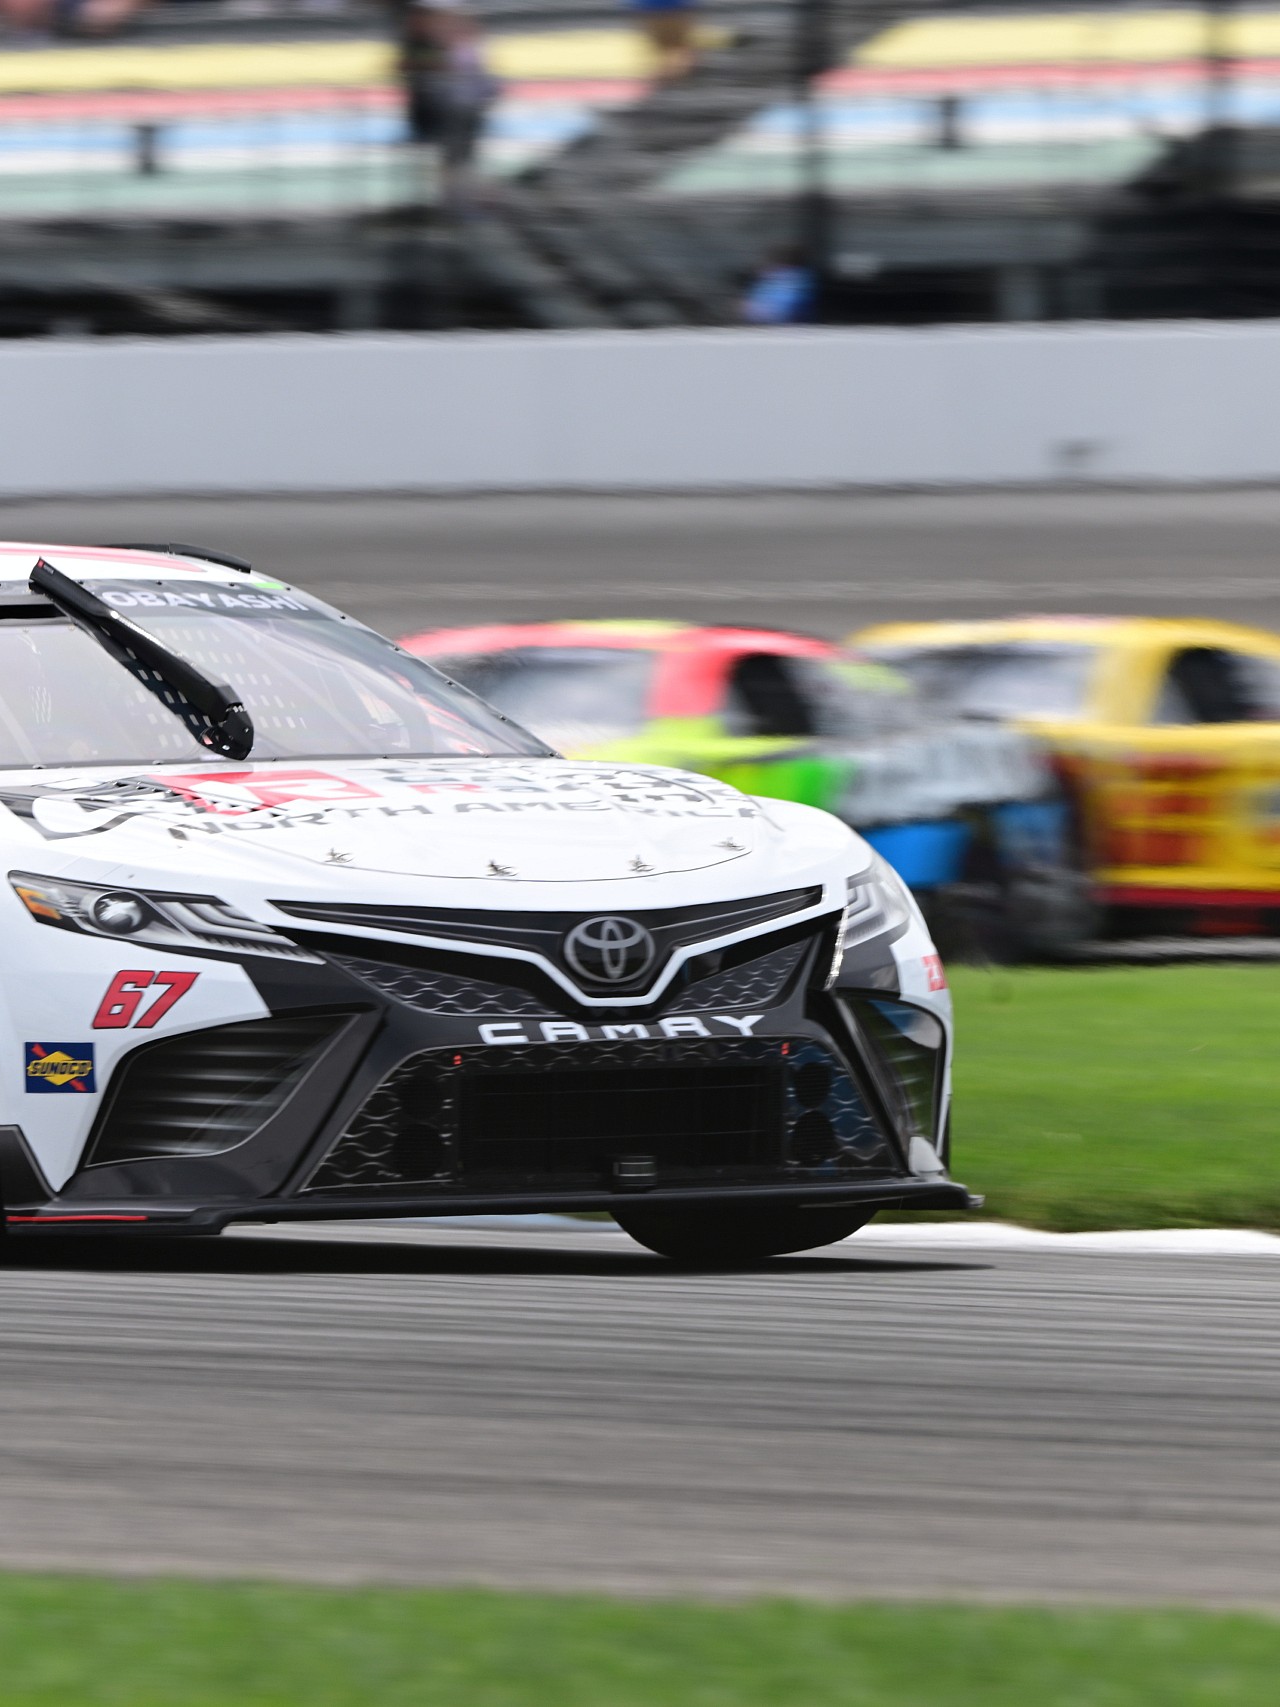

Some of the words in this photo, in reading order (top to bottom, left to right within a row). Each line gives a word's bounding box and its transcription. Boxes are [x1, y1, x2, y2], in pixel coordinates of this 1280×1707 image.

[99, 590, 310, 612] OBAYASHI
[91, 969, 200, 1030] 67
[478, 1014, 765, 1046] CAMRY
[28, 1060, 93, 1076] SUNOCO
